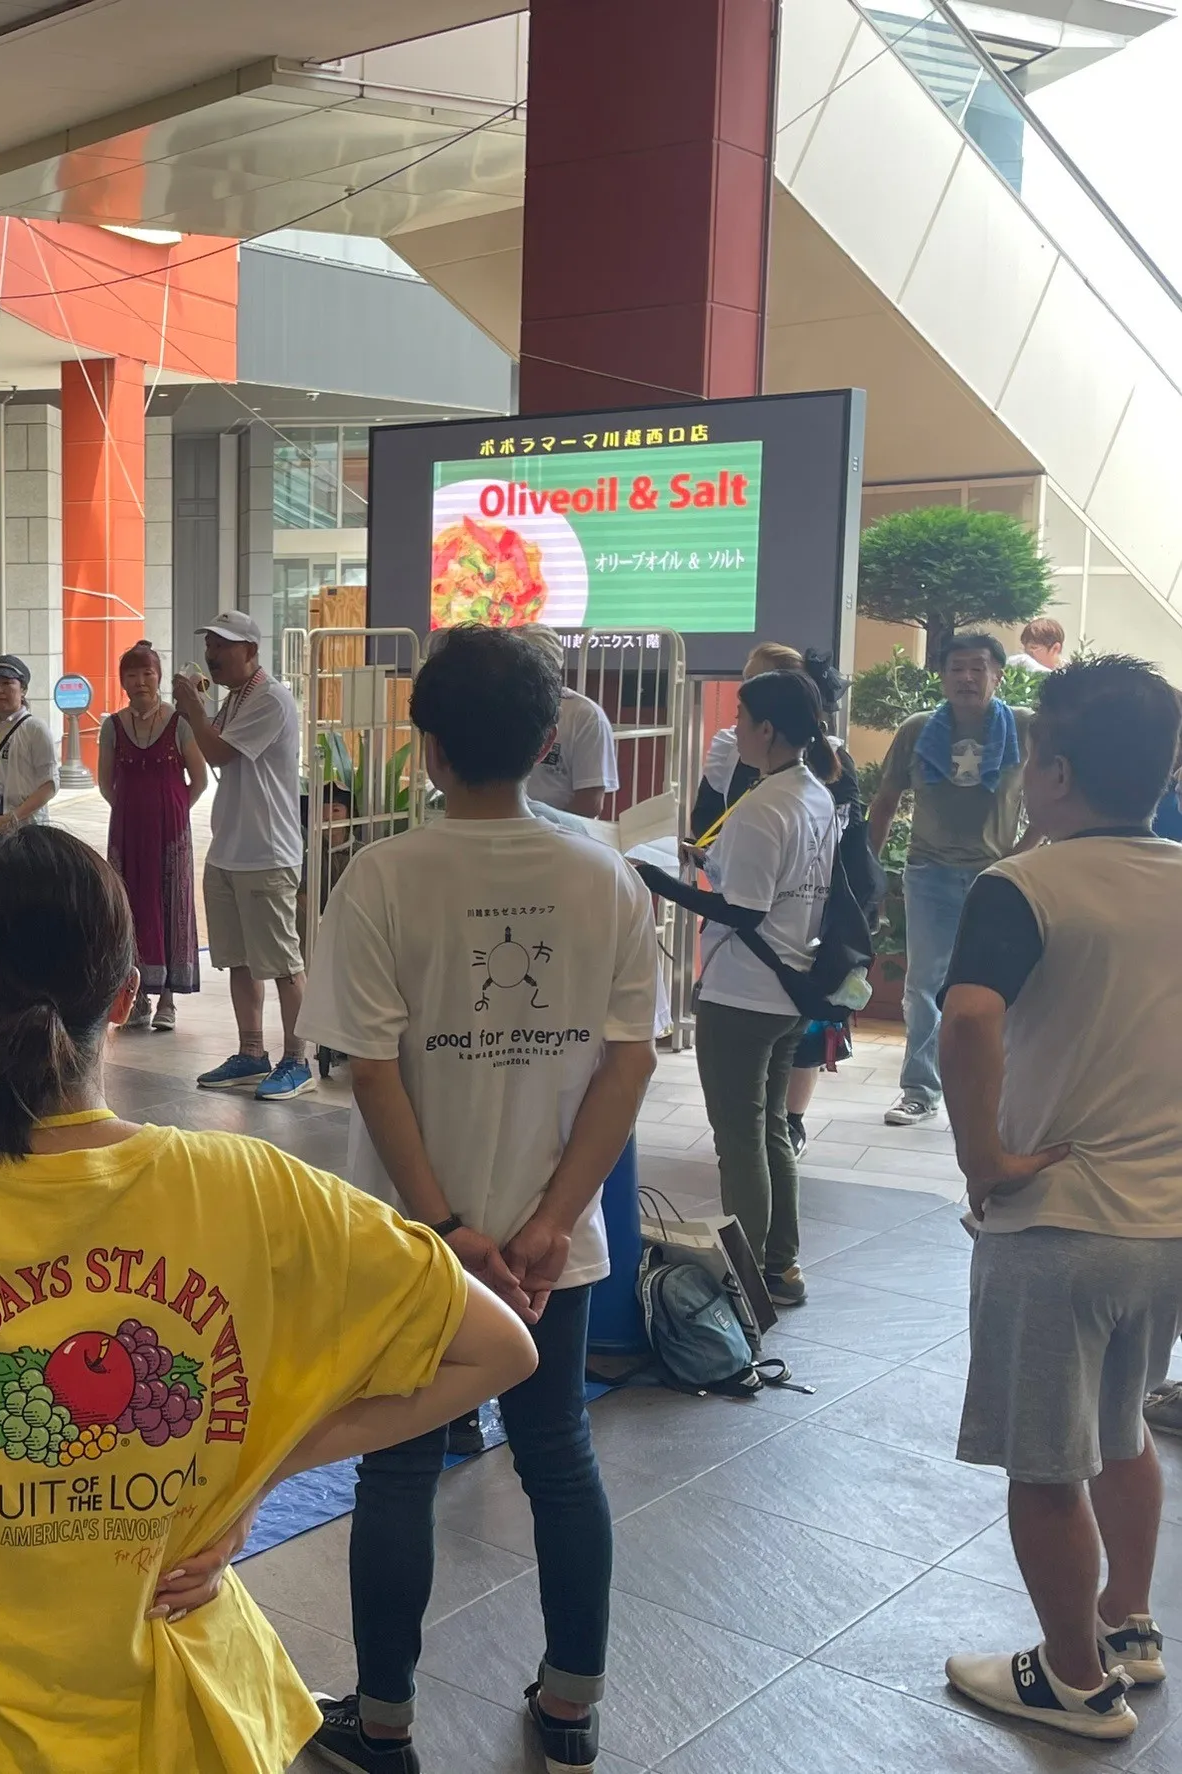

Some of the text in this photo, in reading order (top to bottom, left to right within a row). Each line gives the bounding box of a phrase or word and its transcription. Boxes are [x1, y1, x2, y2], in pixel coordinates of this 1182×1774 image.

[479, 469, 749, 518] Oliveoil & Salt
[707, 549, 746, 570] ソルト
[425, 1028, 591, 1051] good for everyne
[86, 1246, 230, 1335] START
[205, 1315, 251, 1445] WITH
[71, 1475, 100, 1494] OF
[67, 1494, 103, 1513] THE
[0, 1517, 100, 1547] AMERICA'S
